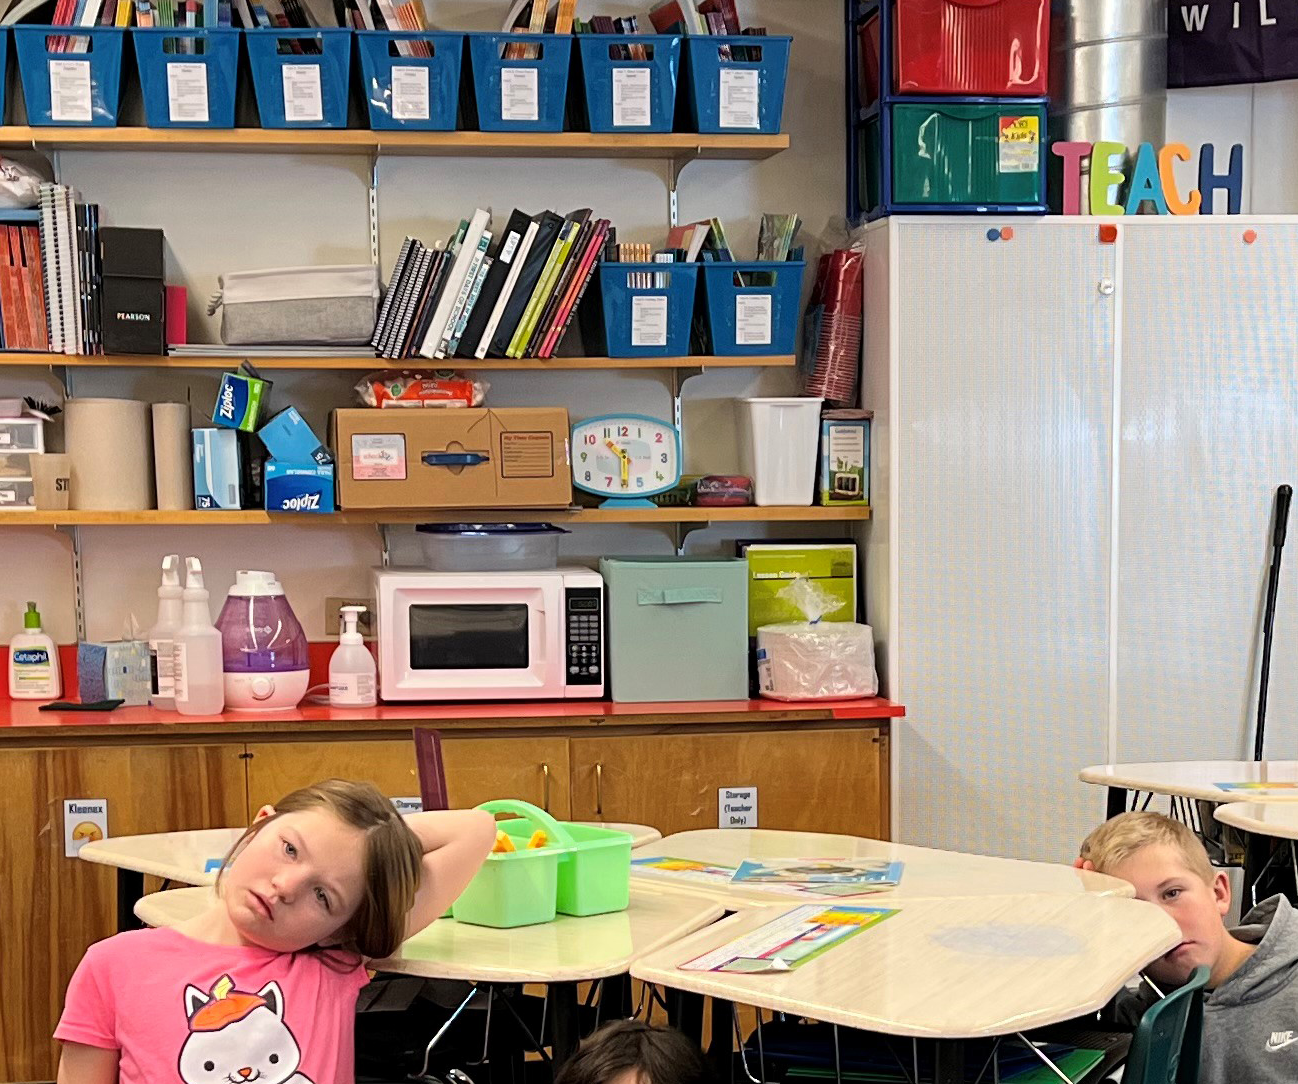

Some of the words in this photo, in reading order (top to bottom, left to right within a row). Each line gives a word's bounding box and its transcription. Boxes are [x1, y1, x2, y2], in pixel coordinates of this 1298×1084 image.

[1052, 141, 1244, 216] TEACH
[116, 312, 151, 321] PEARSON
[447, 306, 461, 331] SCHOOL
[219, 384, 234, 420] Ziploc
[603, 428, 611, 438] 11
[617, 426, 629, 437] 12
[638, 428, 642, 438] 1
[584, 434, 596, 445] 10
[655, 433, 663, 443] 2
[314, 451, 327, 465] 75
[580, 452, 588, 463] 9
[660, 453, 668, 463] 3
[584, 470, 591, 481] 8
[655, 471, 664, 481] 4
[604, 477, 613, 488] 7
[636, 477, 644, 488] 5
[200, 497, 211, 509] 75
[282, 493, 320, 512] Ziploc
[14, 651, 48, 663] Cetaphil
[726, 791, 751, 800] Storage
[68, 803, 104, 814] Kleenex
[724, 803, 753, 813] (Teacher
[730, 816, 747, 825] Only)
[1271, 1030, 1294, 1045] NIKE
